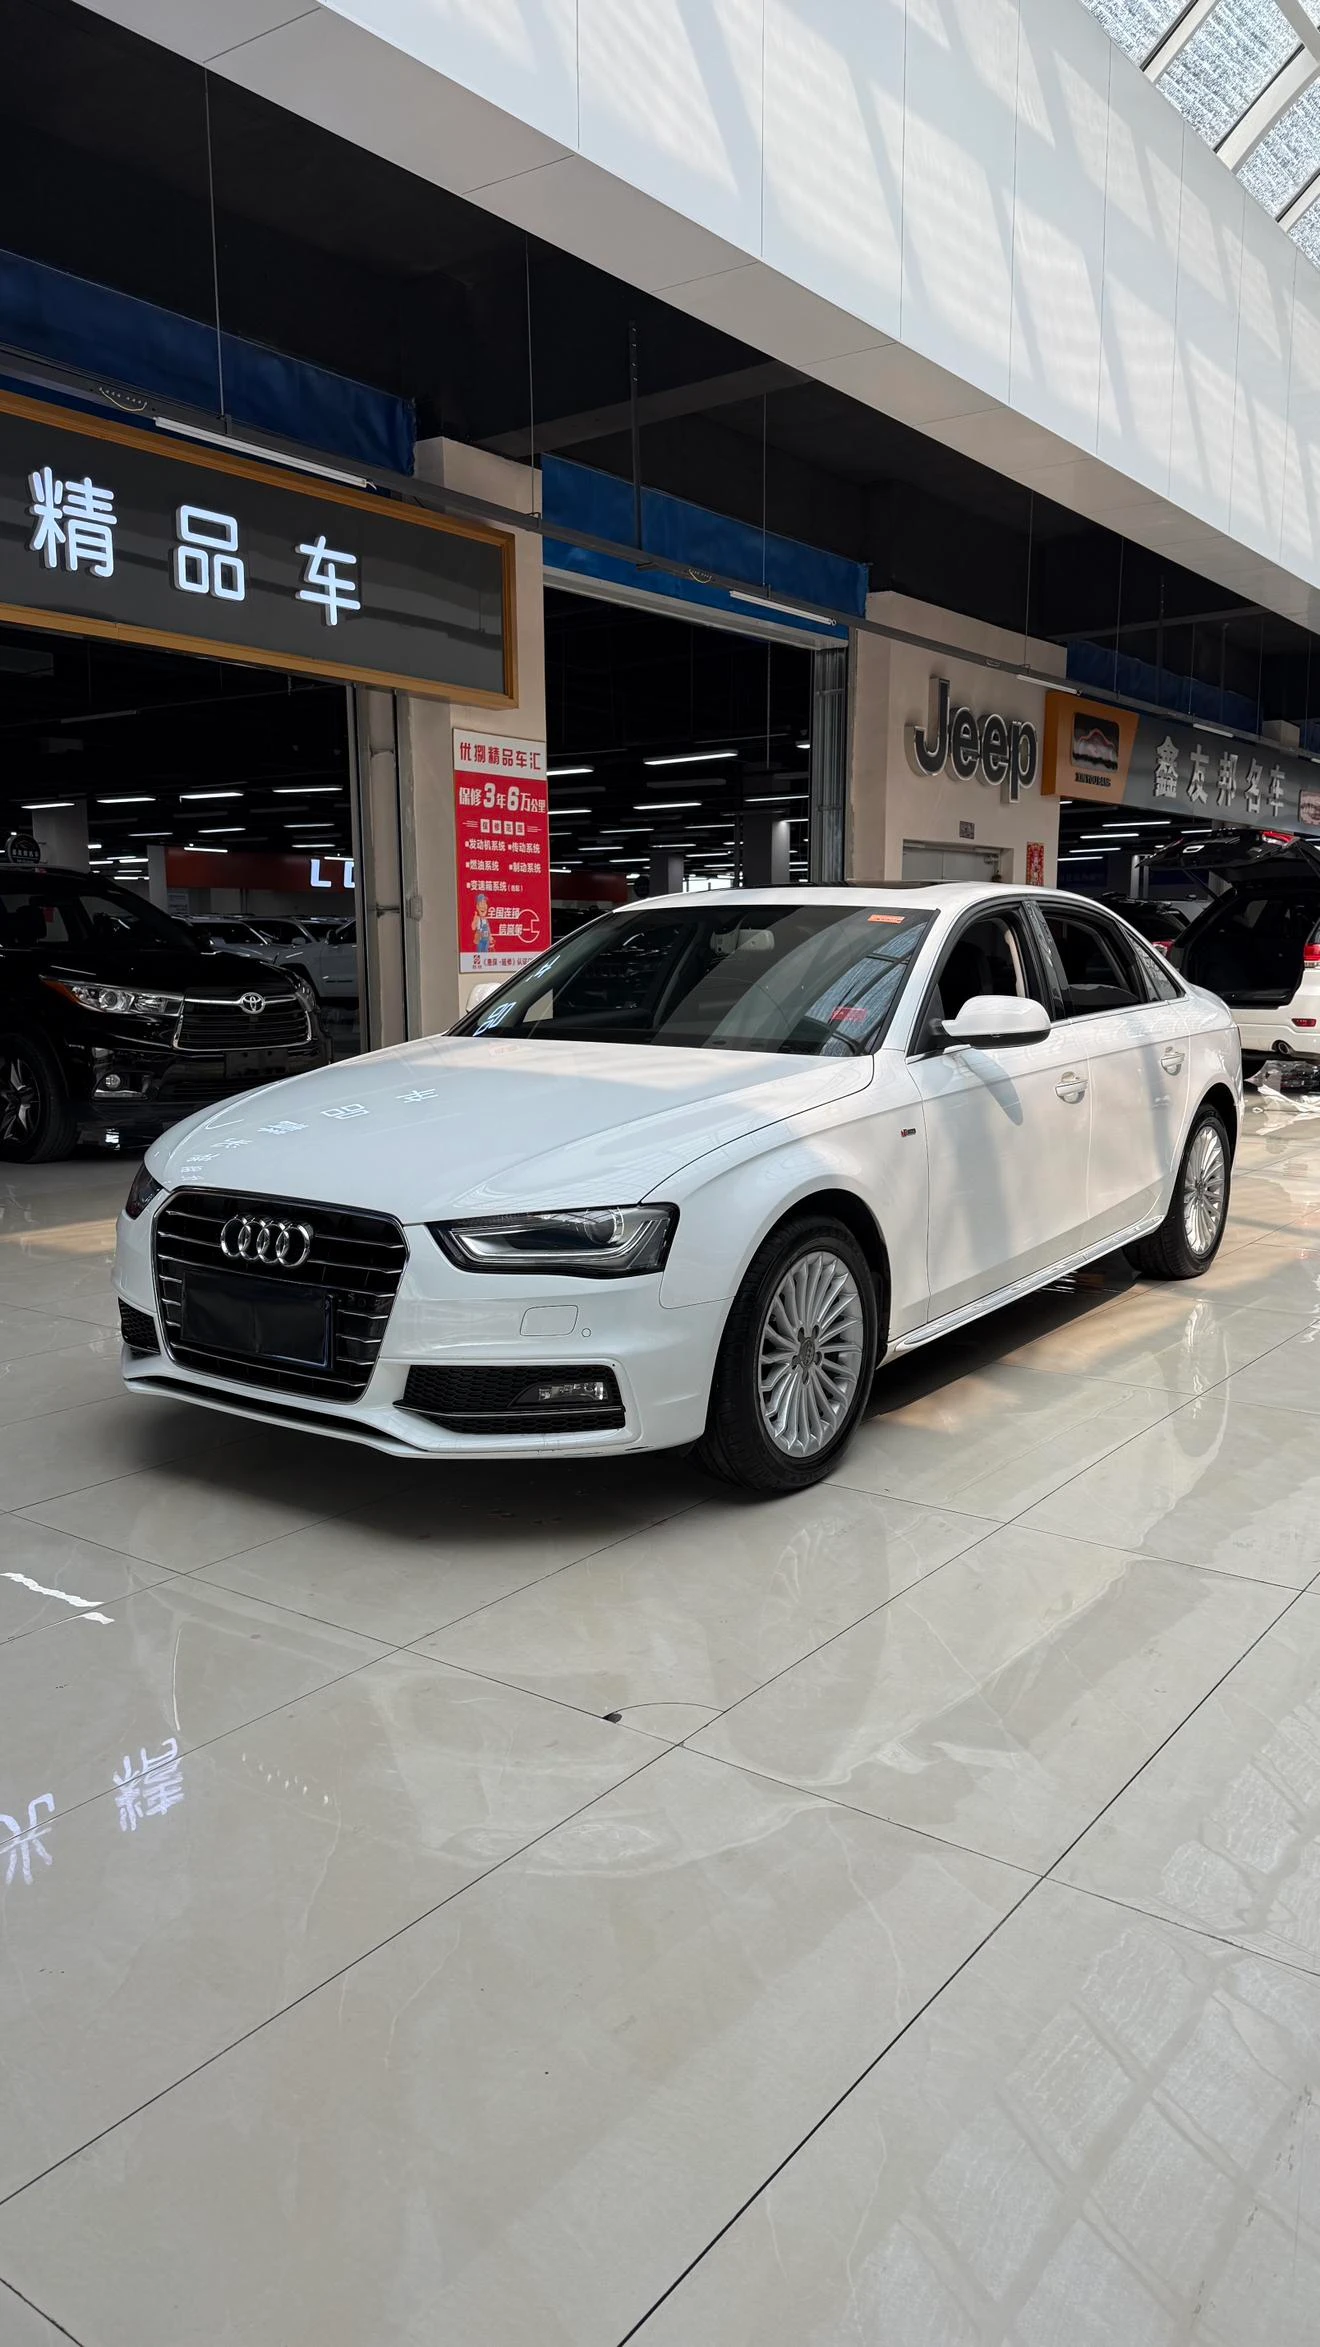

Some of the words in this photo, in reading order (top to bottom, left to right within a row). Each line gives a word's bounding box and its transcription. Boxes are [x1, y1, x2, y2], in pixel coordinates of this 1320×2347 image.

[28, 466, 361, 627] 精品车
[905, 676, 1038, 804] Jeep
[1154, 735, 1286, 817] 鑫友邦名车
[458, 782, 546, 814] 保修3年6万公里
[469, 838, 507, 853] 发动机系统
